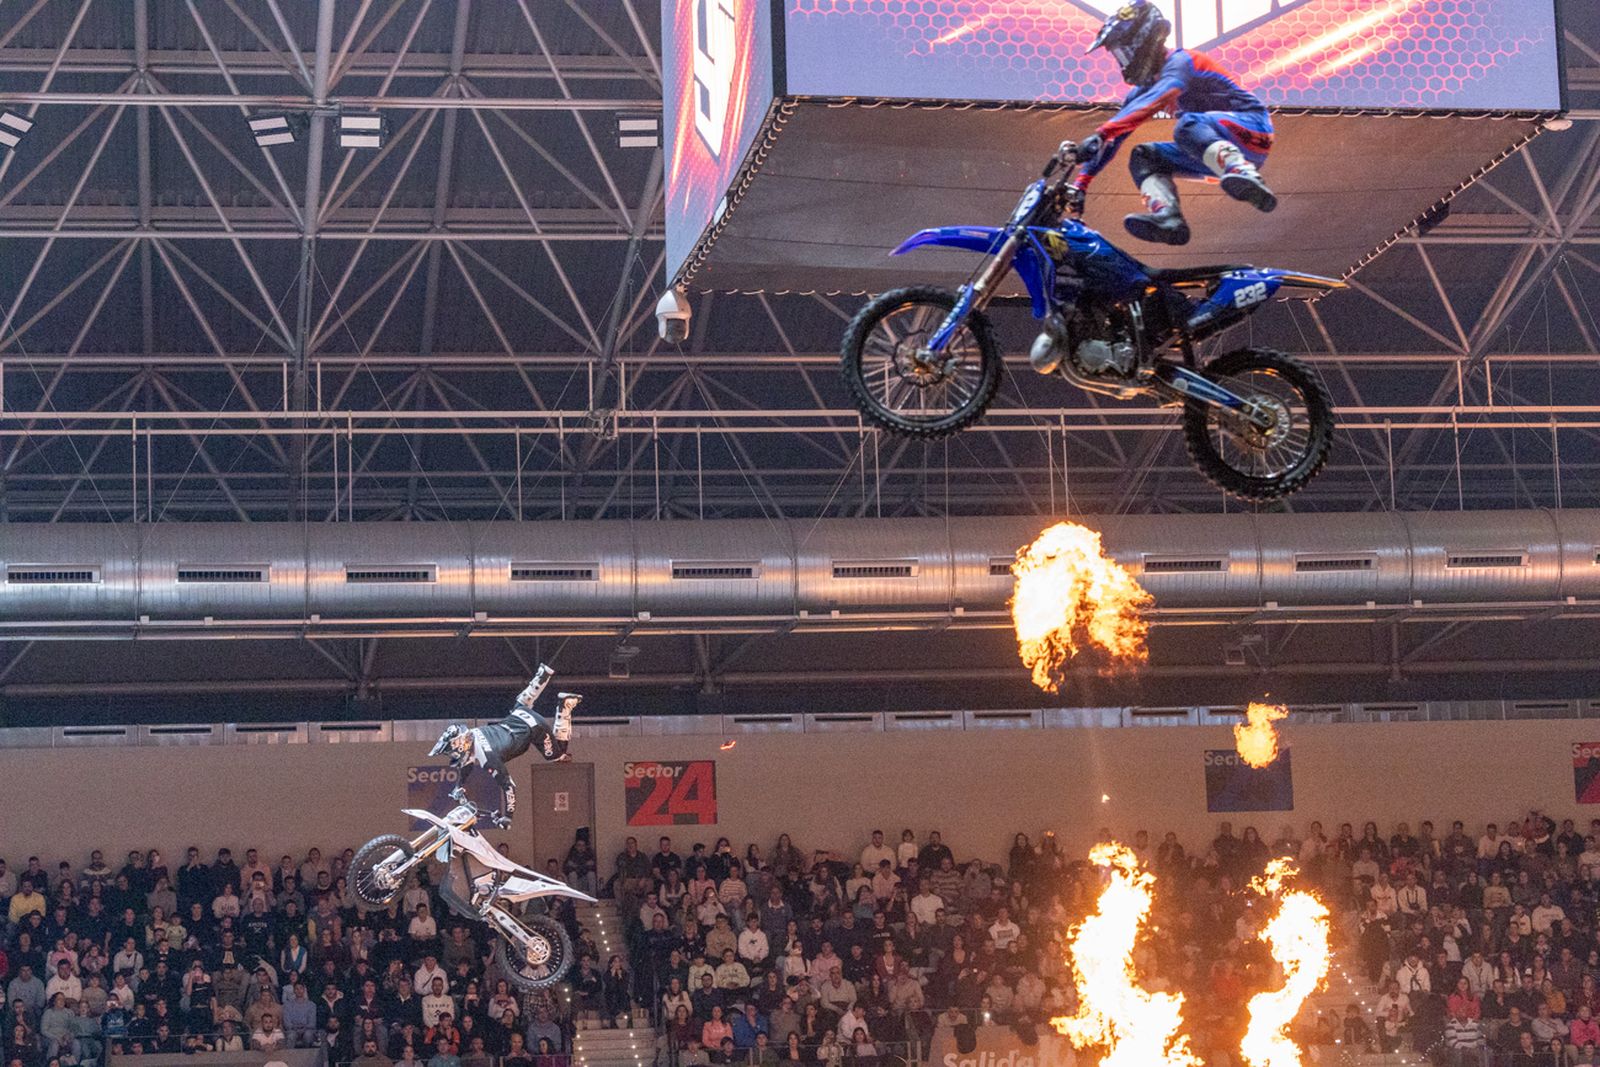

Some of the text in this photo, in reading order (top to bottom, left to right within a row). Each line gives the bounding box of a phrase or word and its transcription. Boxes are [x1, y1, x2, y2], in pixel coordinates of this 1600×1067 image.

[1233, 281, 1267, 309] 232
[1572, 743, 1600, 758] Sec
[408, 767, 458, 783] Secto
[624, 763, 682, 779] Sector
[624, 761, 718, 827] 24
